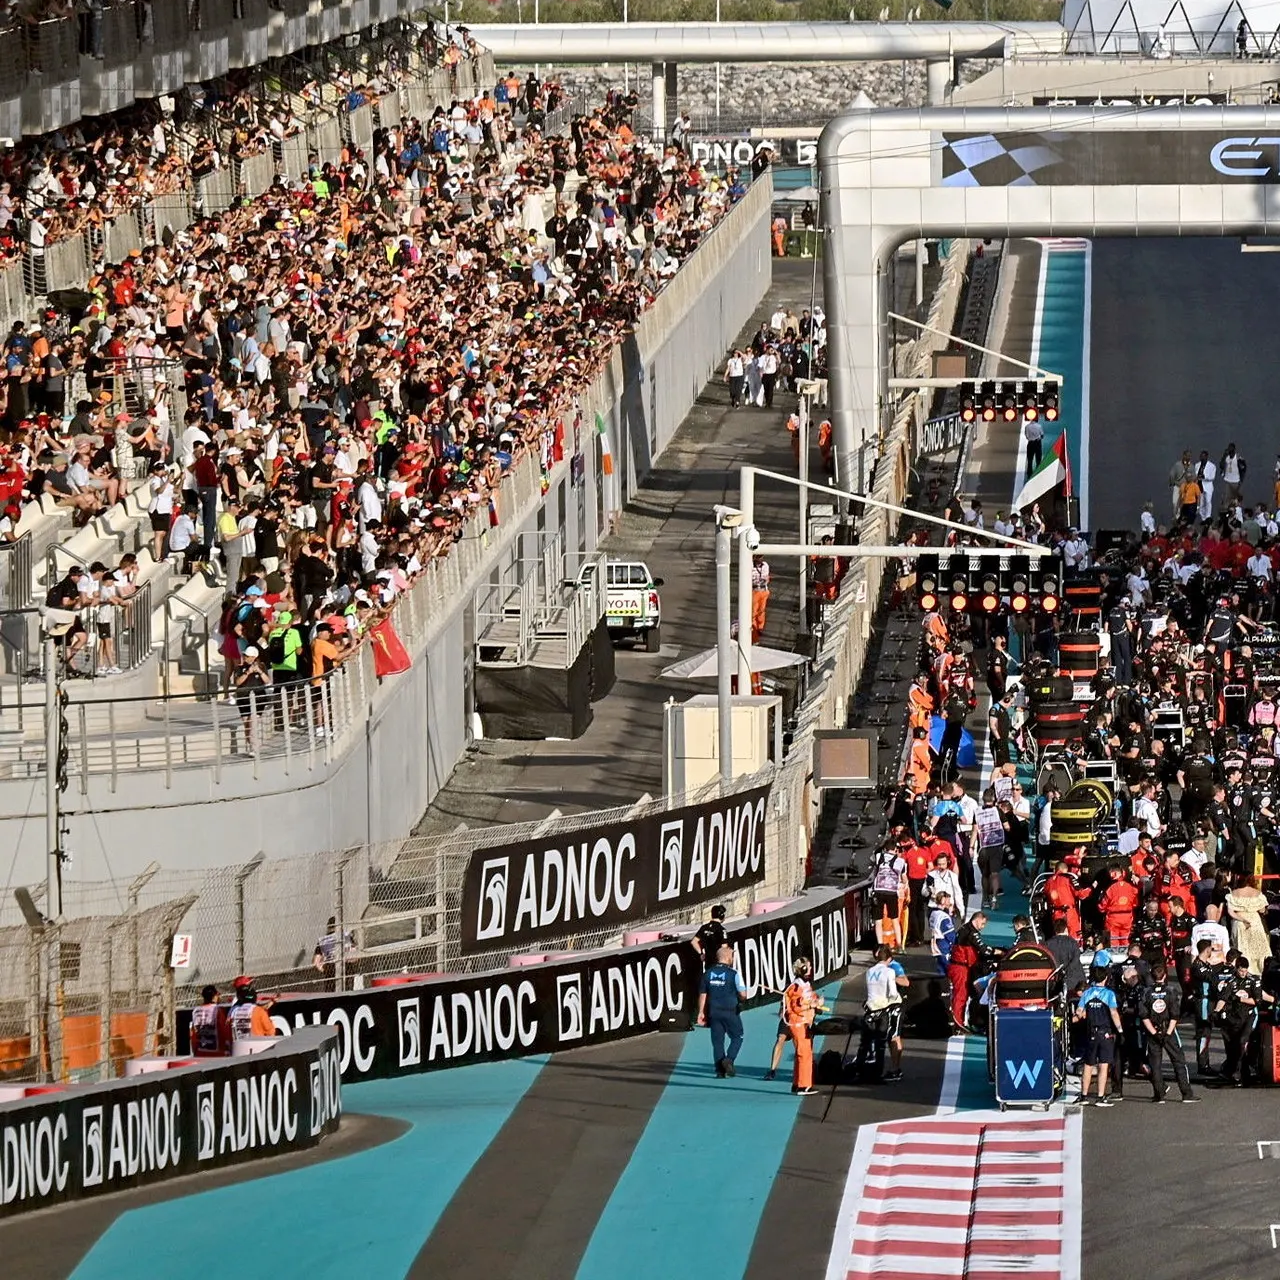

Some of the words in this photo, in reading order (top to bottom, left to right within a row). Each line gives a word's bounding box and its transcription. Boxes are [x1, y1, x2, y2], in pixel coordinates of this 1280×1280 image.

[606, 599, 639, 609] YOTA
[513, 831, 637, 933] ADNOC
[687, 796, 765, 893] ADNOC
[428, 980, 539, 1062] ADNOC
[589, 952, 686, 1036] ADNOC
[107, 1089, 182, 1181] ADNOC
[219, 1067, 298, 1155] ADNOC
